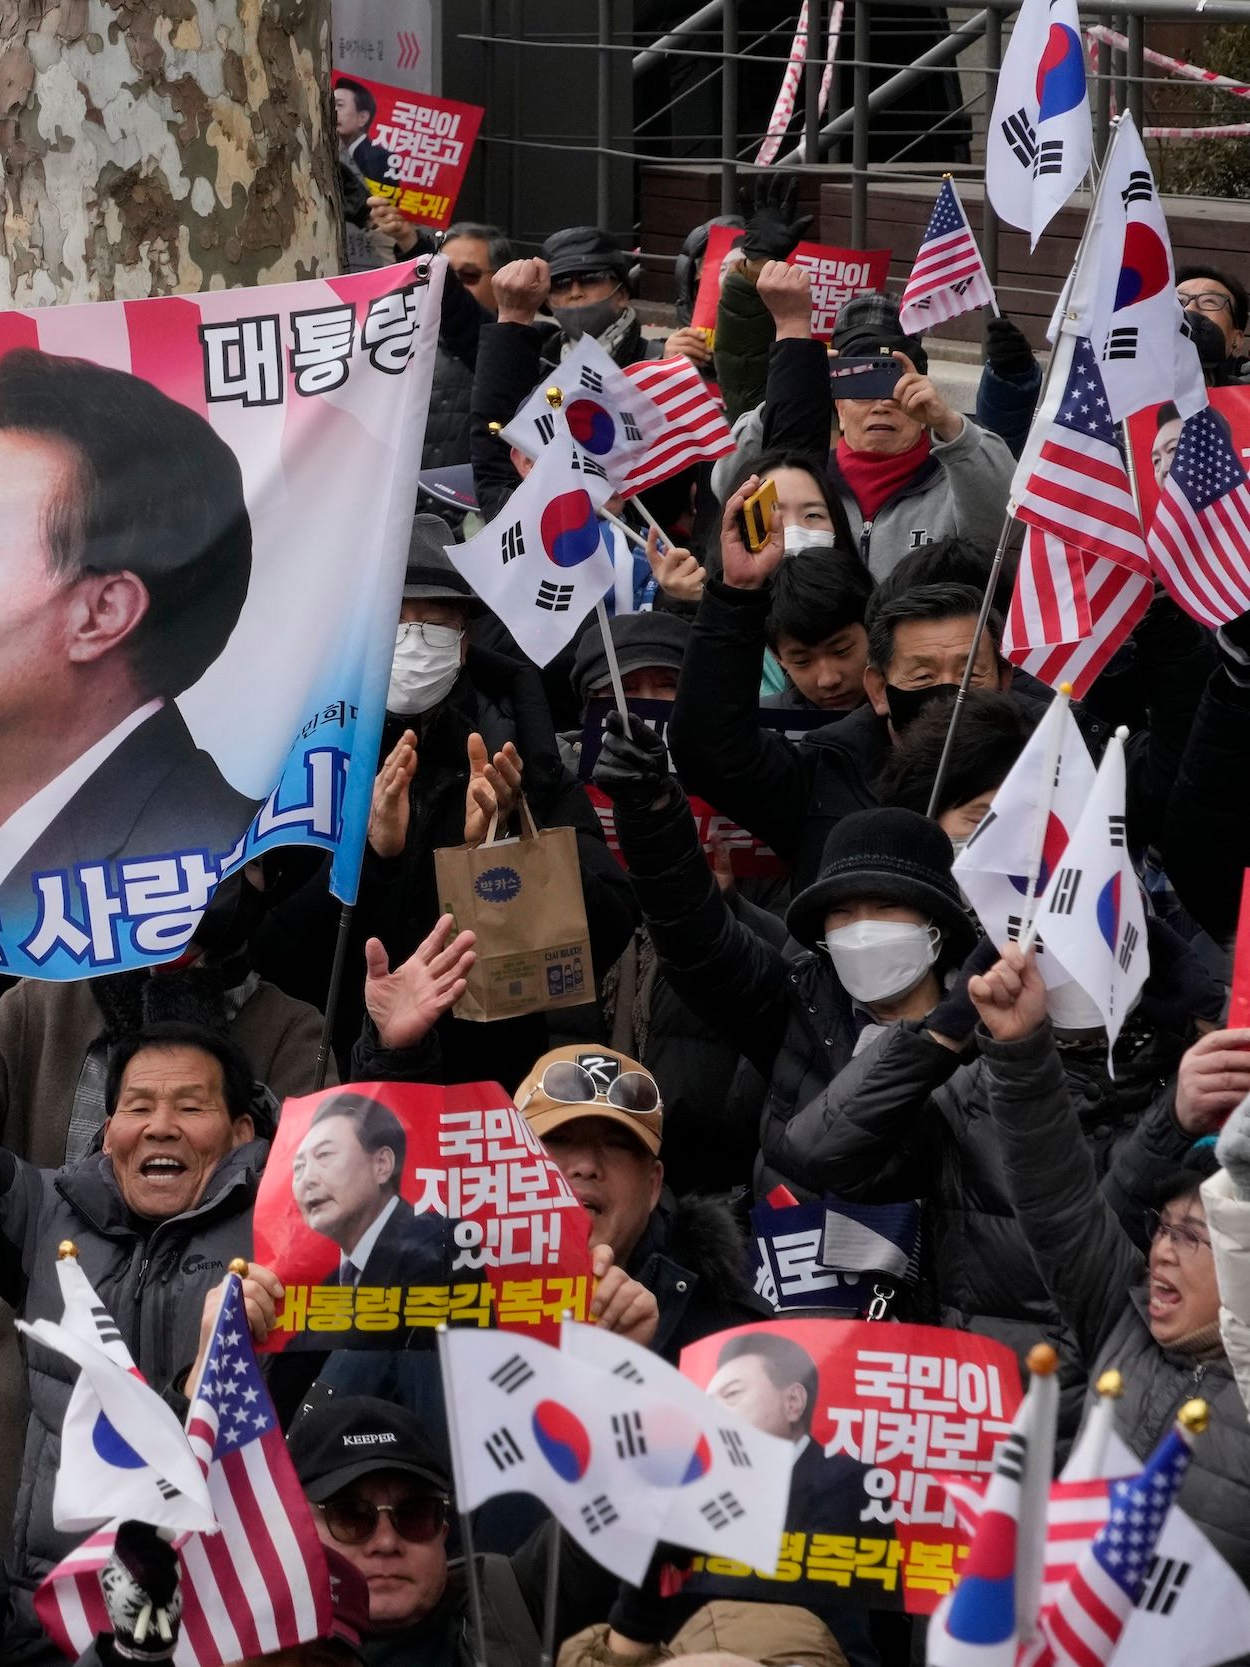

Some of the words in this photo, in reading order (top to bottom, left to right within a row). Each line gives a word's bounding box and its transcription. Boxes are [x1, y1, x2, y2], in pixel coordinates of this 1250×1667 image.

[391, 101, 461, 138] 국민이
[371, 123, 463, 166] 지켜보고
[383, 154, 440, 188] 있다!
[399, 189, 450, 220] 복귀!
[198, 280, 430, 408] 대통령
[480, 878, 519, 892] 박카스
[439, 1108, 549, 1163] 국민이
[414, 1160, 580, 1219] 지켜보고
[452, 1213, 562, 1271] 있다!
[197, 1261, 224, 1271] NEPA
[403, 1281, 495, 1331] 즉각
[855, 1350, 1003, 1418] 국민이
[342, 1432, 397, 1446] KEEPER
[806, 1533, 905, 1591] 즉각
[904, 1541, 971, 1595] 복
